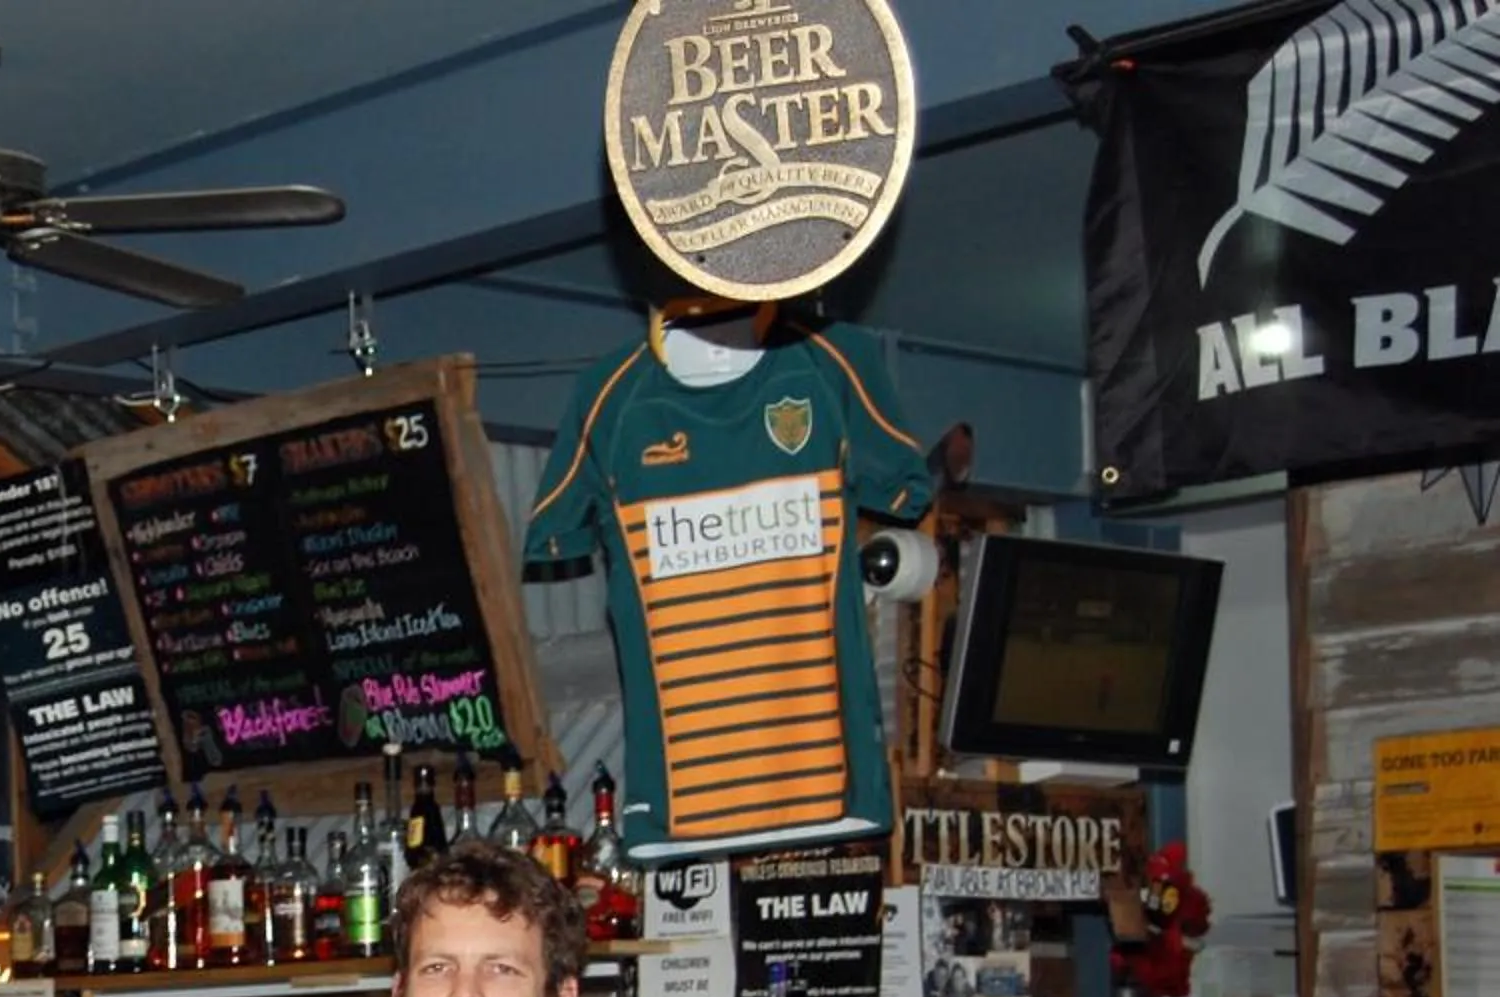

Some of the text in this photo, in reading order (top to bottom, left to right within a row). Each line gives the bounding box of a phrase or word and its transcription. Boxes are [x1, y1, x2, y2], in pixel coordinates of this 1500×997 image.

[663, 24, 847, 106] BEER
[630, 82, 895, 175] MASTER
[737, 167, 818, 192] QUALITY
[750, 201, 864, 224] MANAGEMENT
[1197, 276, 1500, 401] ALL BL
[658, 532, 818, 573] ASHBURTON
[28, 577, 109, 612] offence!
[42, 622, 91, 660] 25
[28, 685, 135, 727] THE LAW
[662, 911, 687, 924] FREE
[756, 891, 869, 920] THE LAW
[661, 956, 710, 971] CHILDREN
[664, 979, 709, 992] MUST BE
